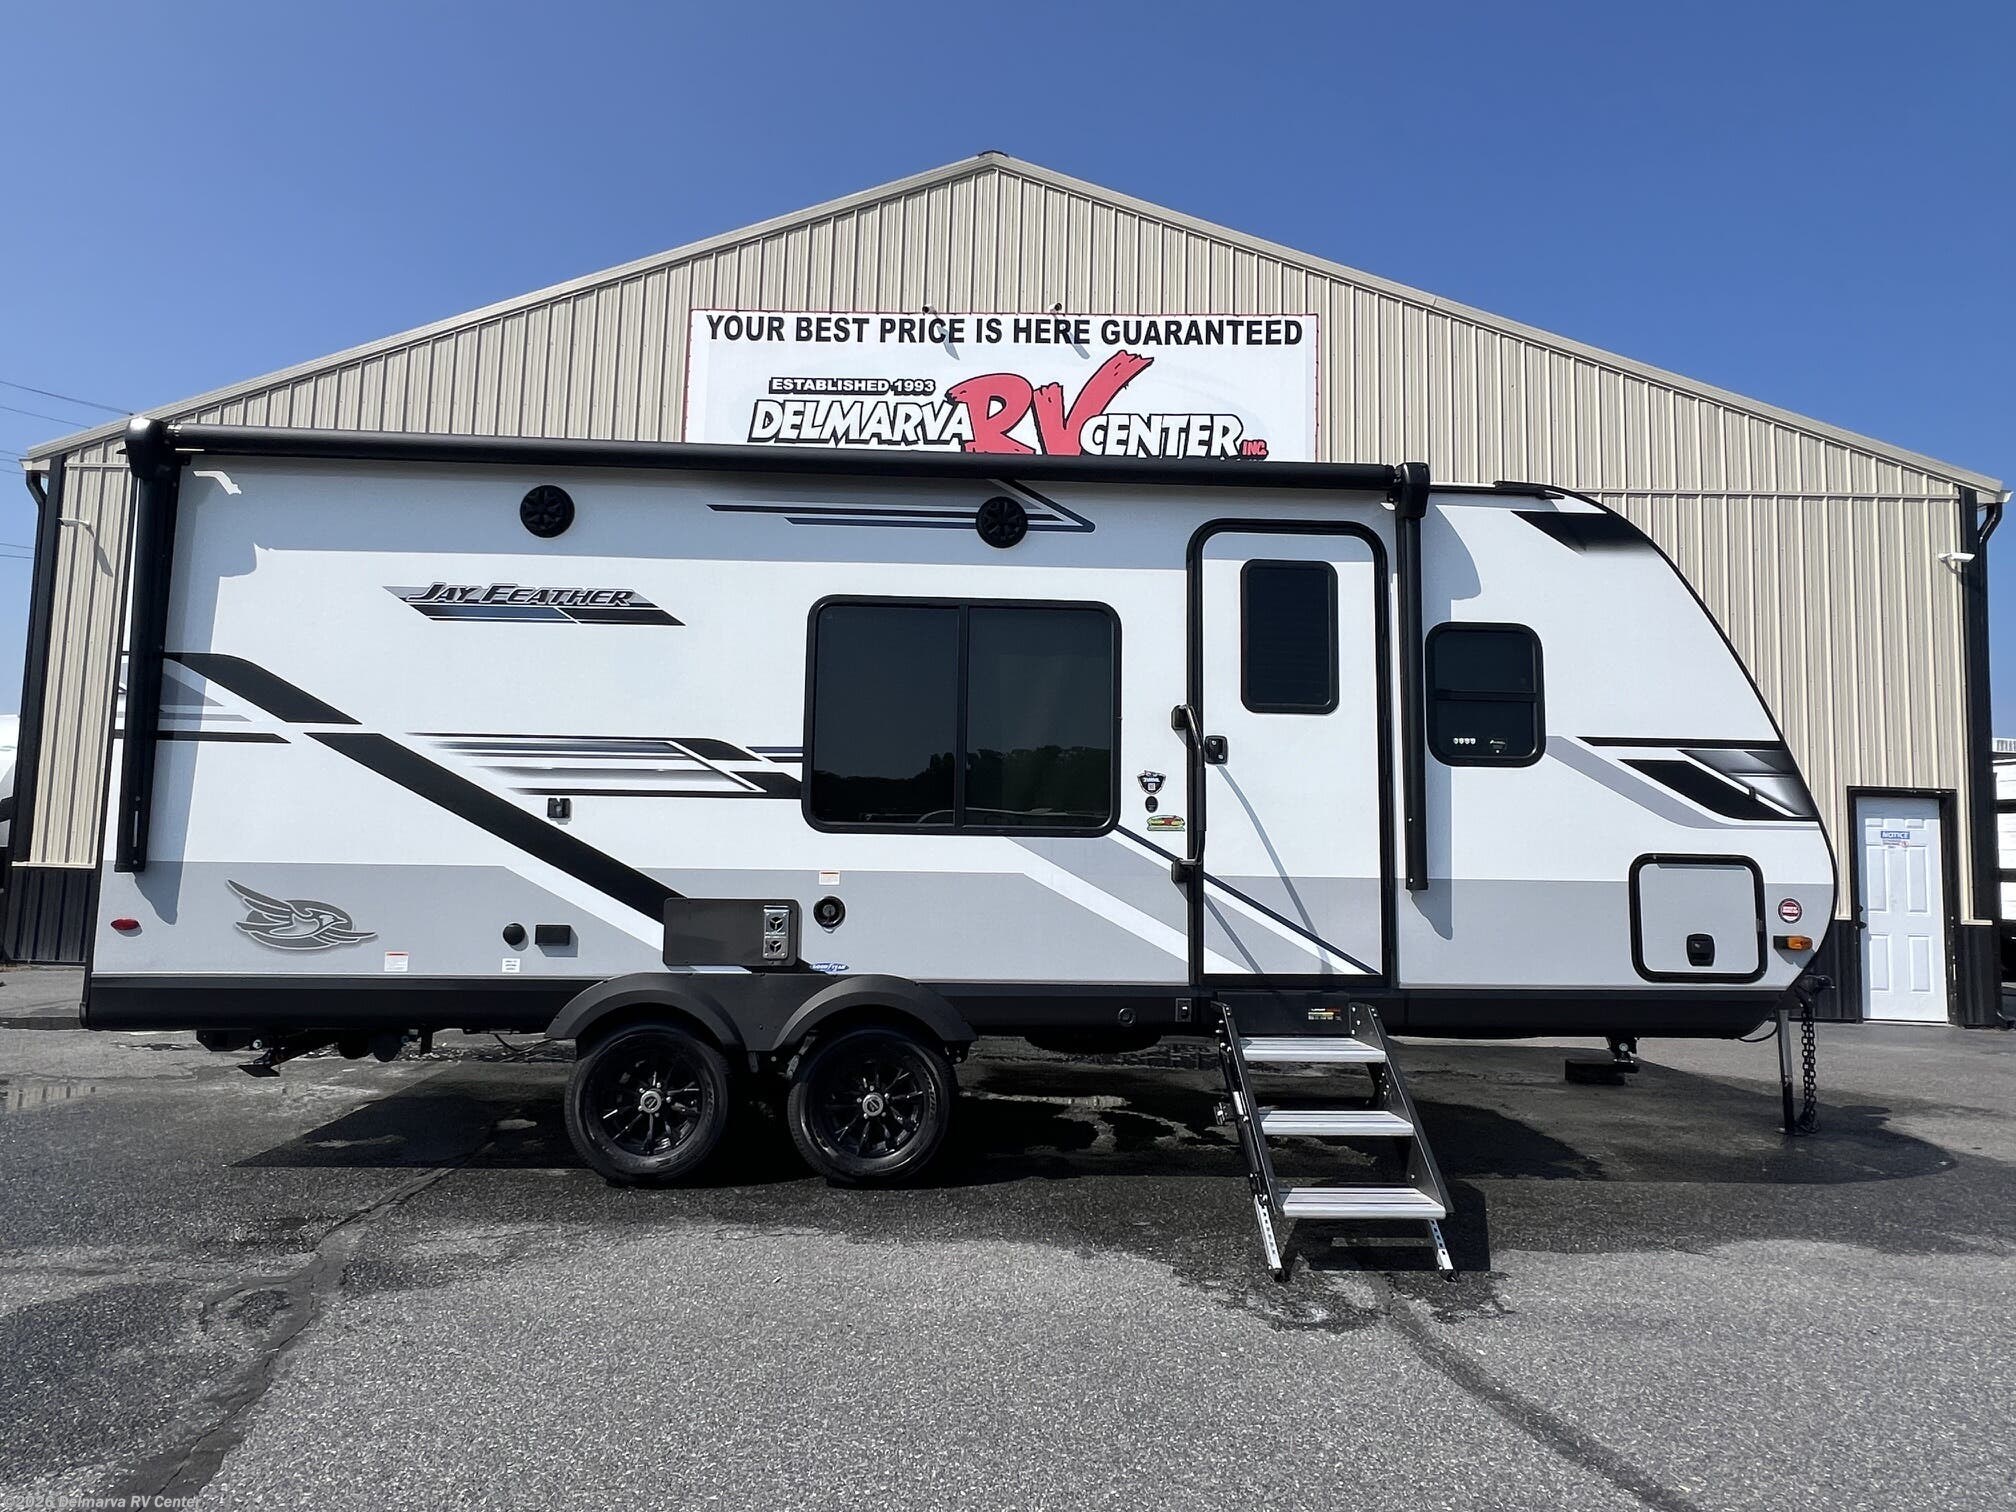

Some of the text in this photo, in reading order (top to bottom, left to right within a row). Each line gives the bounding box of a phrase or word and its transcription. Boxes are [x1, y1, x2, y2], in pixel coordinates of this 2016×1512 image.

[706, 314, 1302, 346] YOUR BEST PRICE IS HERE GUARANTEED
[770, 377, 936, 394] ESTABLISHED 1993
[748, 399, 975, 446] DELMARVA
[945, 350, 1154, 456] RV
[1079, 413, 1243, 457] CENTER
[407, 582, 636, 606] JAY FEATHER
